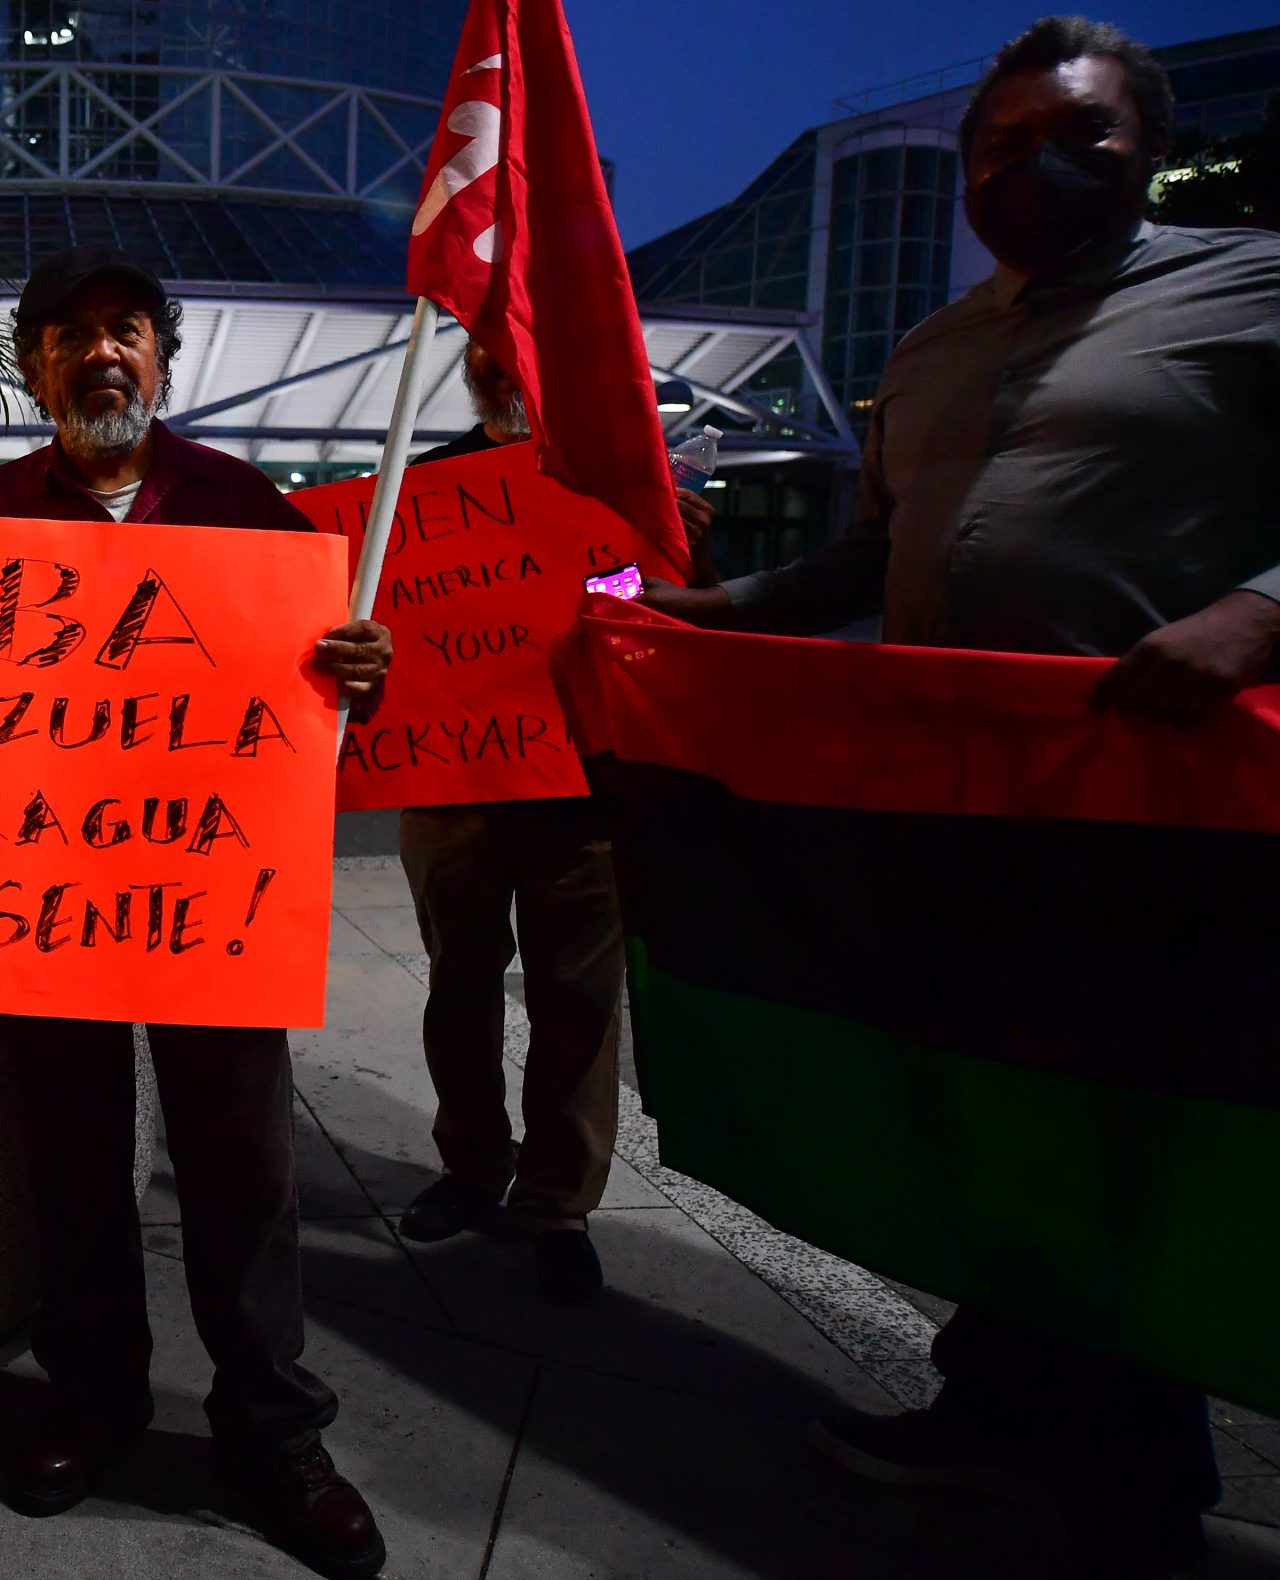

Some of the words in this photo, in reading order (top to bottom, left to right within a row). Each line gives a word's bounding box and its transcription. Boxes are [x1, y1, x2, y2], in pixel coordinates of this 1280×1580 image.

[333, 476, 515, 558] IDEN
[392, 553, 542, 608] AMERICA
[588, 544, 621, 566] IS
[424, 624, 542, 666] YOUR
[337, 713, 576, 773] ACKYAR
